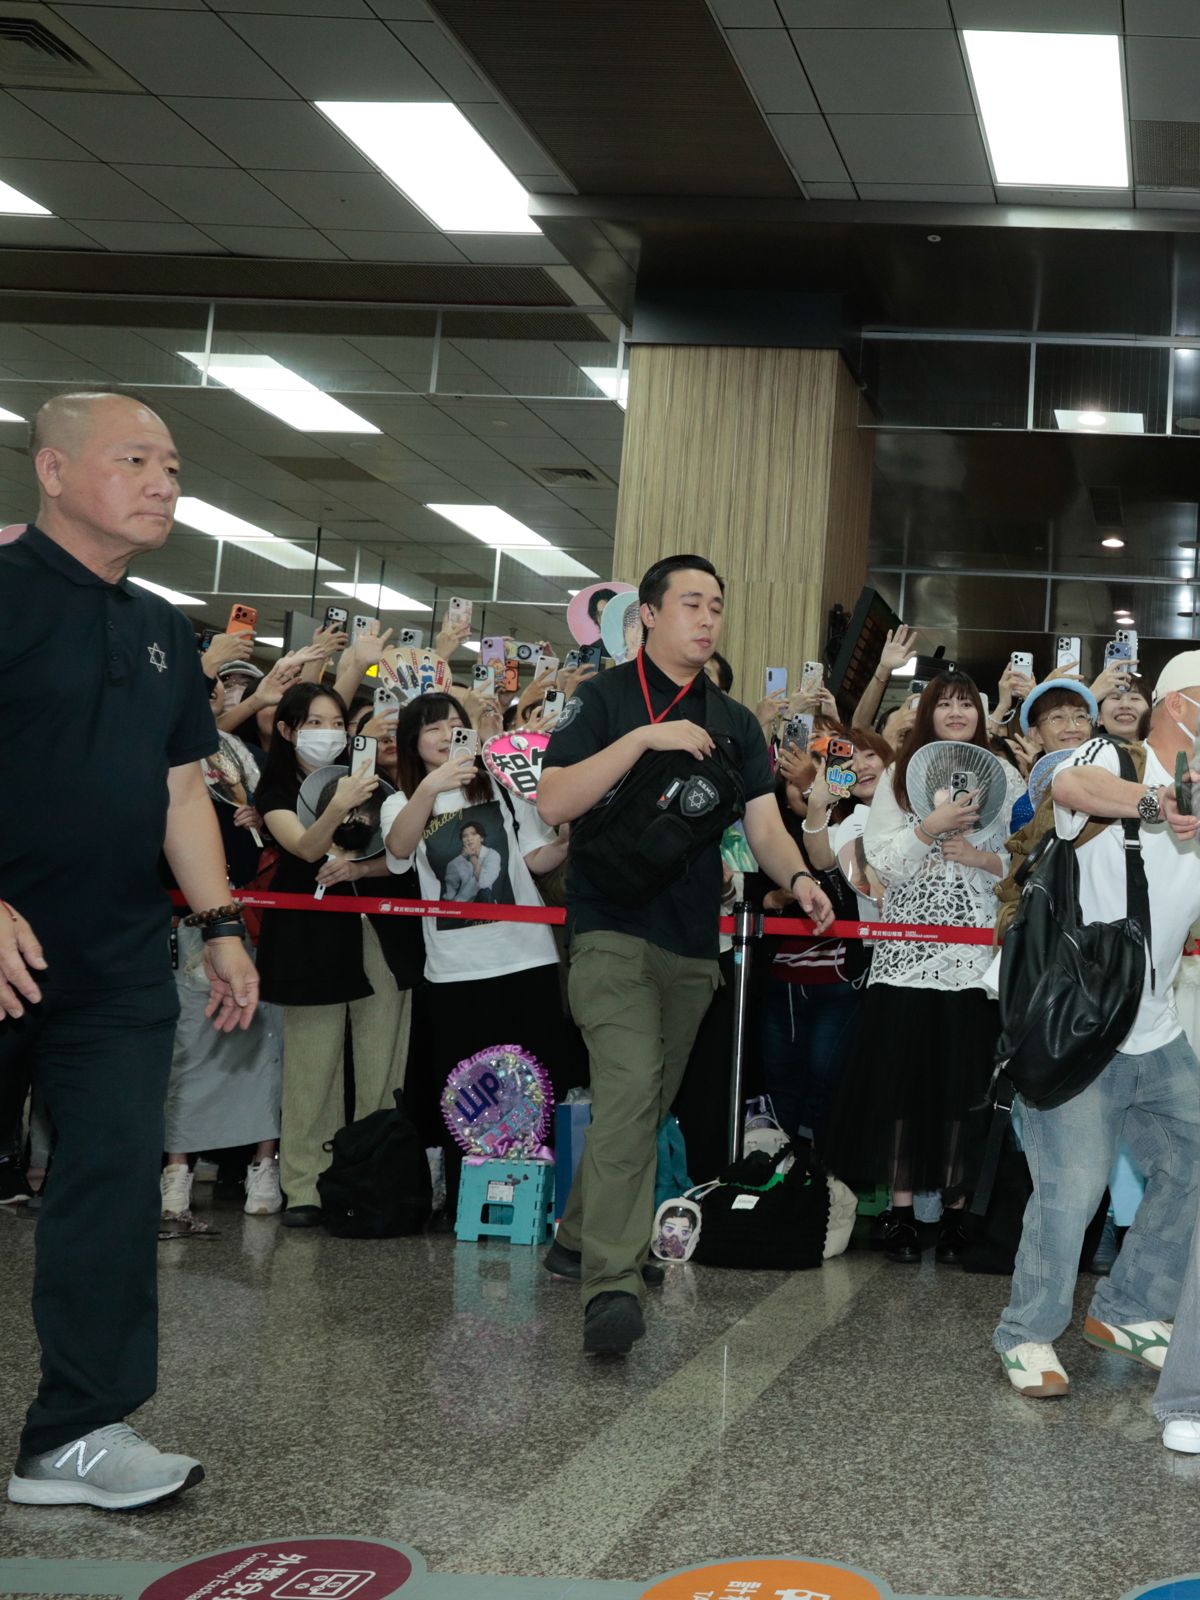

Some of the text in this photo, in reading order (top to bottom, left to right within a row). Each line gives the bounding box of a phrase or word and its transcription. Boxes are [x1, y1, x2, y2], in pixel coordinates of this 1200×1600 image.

[423, 807, 463, 840] irthday
[53, 1440, 109, 1478] N
[211, 1553, 308, 1600] 外幣兌
[215, 1551, 268, 1580] Currency
